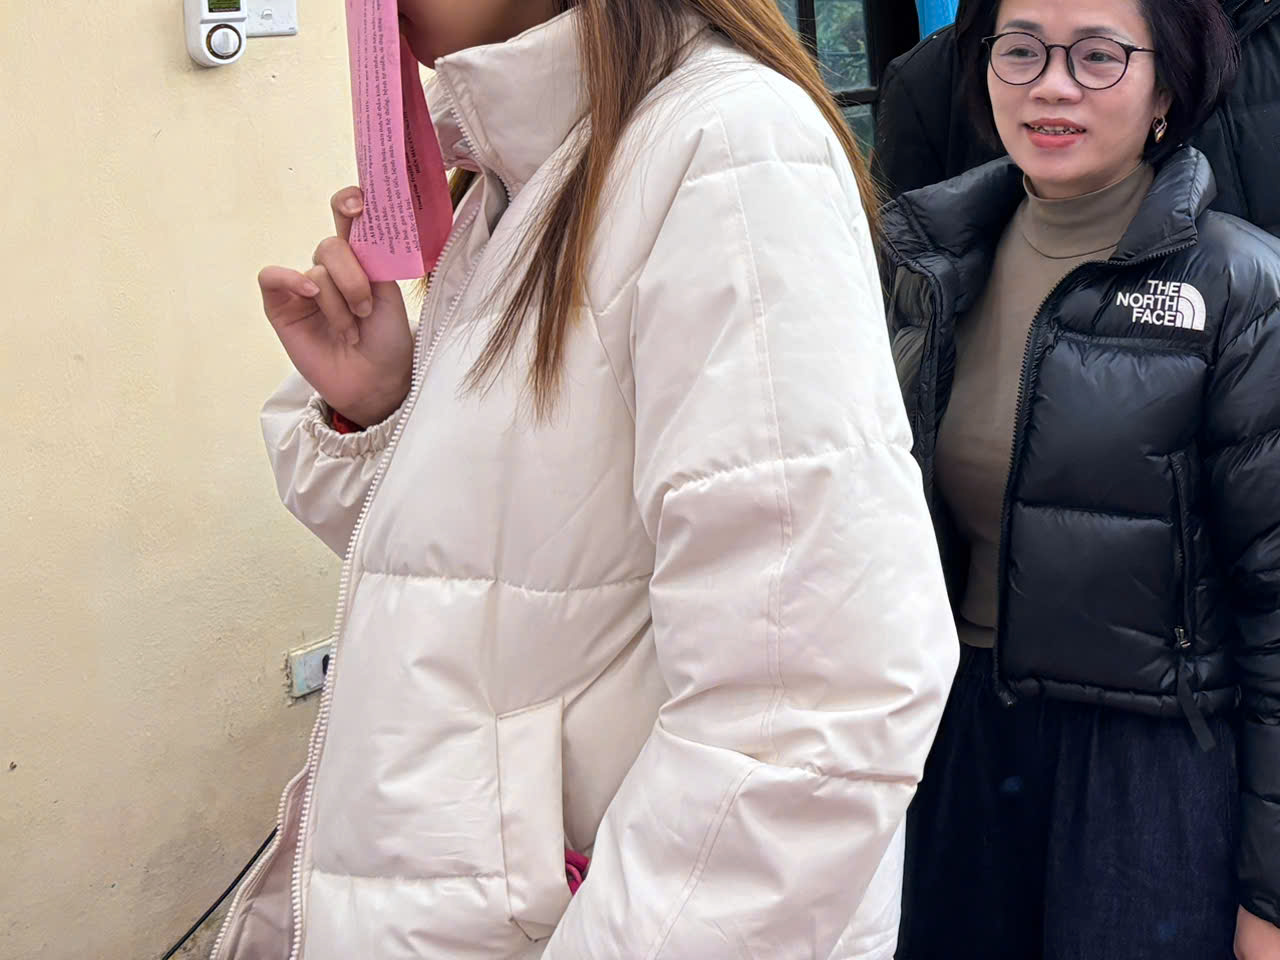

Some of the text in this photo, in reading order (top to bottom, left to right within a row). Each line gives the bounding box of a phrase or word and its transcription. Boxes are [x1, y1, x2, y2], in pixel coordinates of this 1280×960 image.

[1147, 280, 1181, 296] THE
[1116, 291, 1178, 312] NORTH
[1132, 307, 1177, 327] FACE
